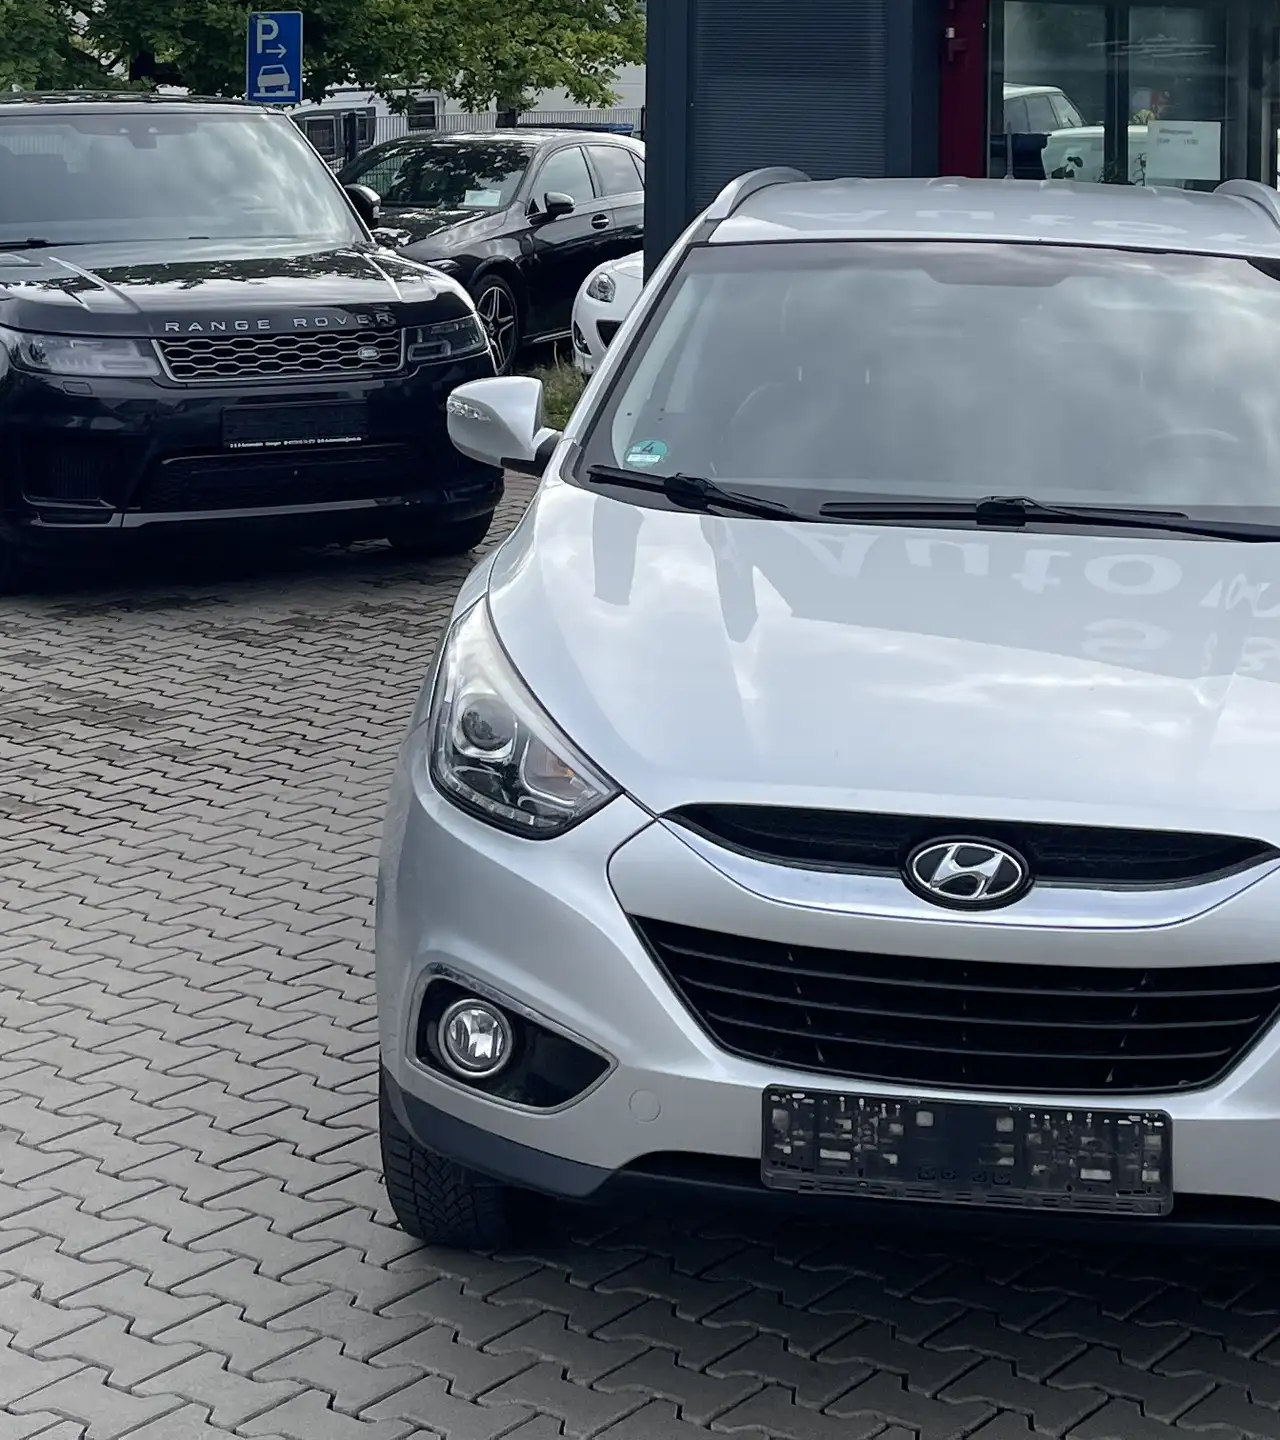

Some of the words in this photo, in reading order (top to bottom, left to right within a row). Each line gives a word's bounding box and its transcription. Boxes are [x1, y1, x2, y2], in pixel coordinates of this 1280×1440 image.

[257, 18, 279, 54] P
[165, 320, 270, 333] RANGE
[293, 313, 392, 329] ROVER
